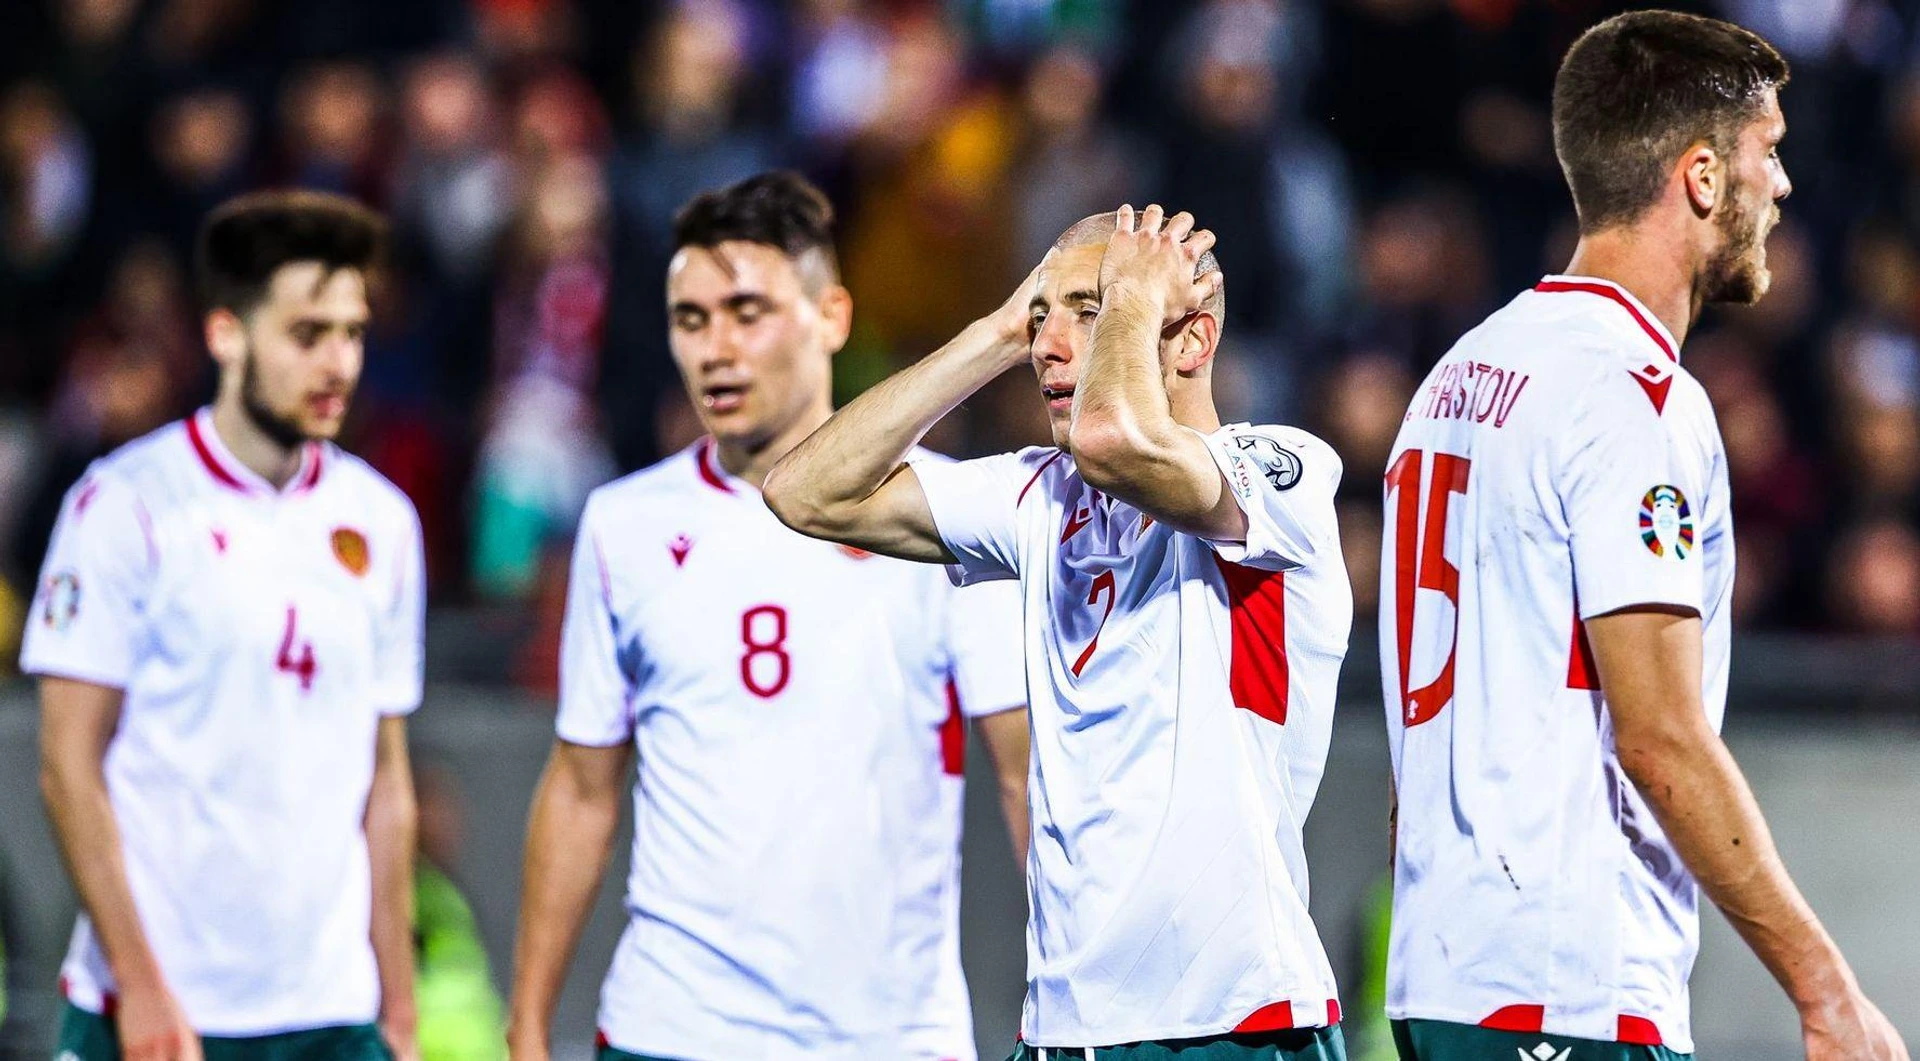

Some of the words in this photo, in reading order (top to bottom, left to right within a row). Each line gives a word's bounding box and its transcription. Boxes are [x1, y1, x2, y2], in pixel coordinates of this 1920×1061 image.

[1070, 569, 1116, 679] 7
[1384, 448, 1471, 728] 15
[276, 606, 316, 690] 4
[741, 605, 790, 697] 8
